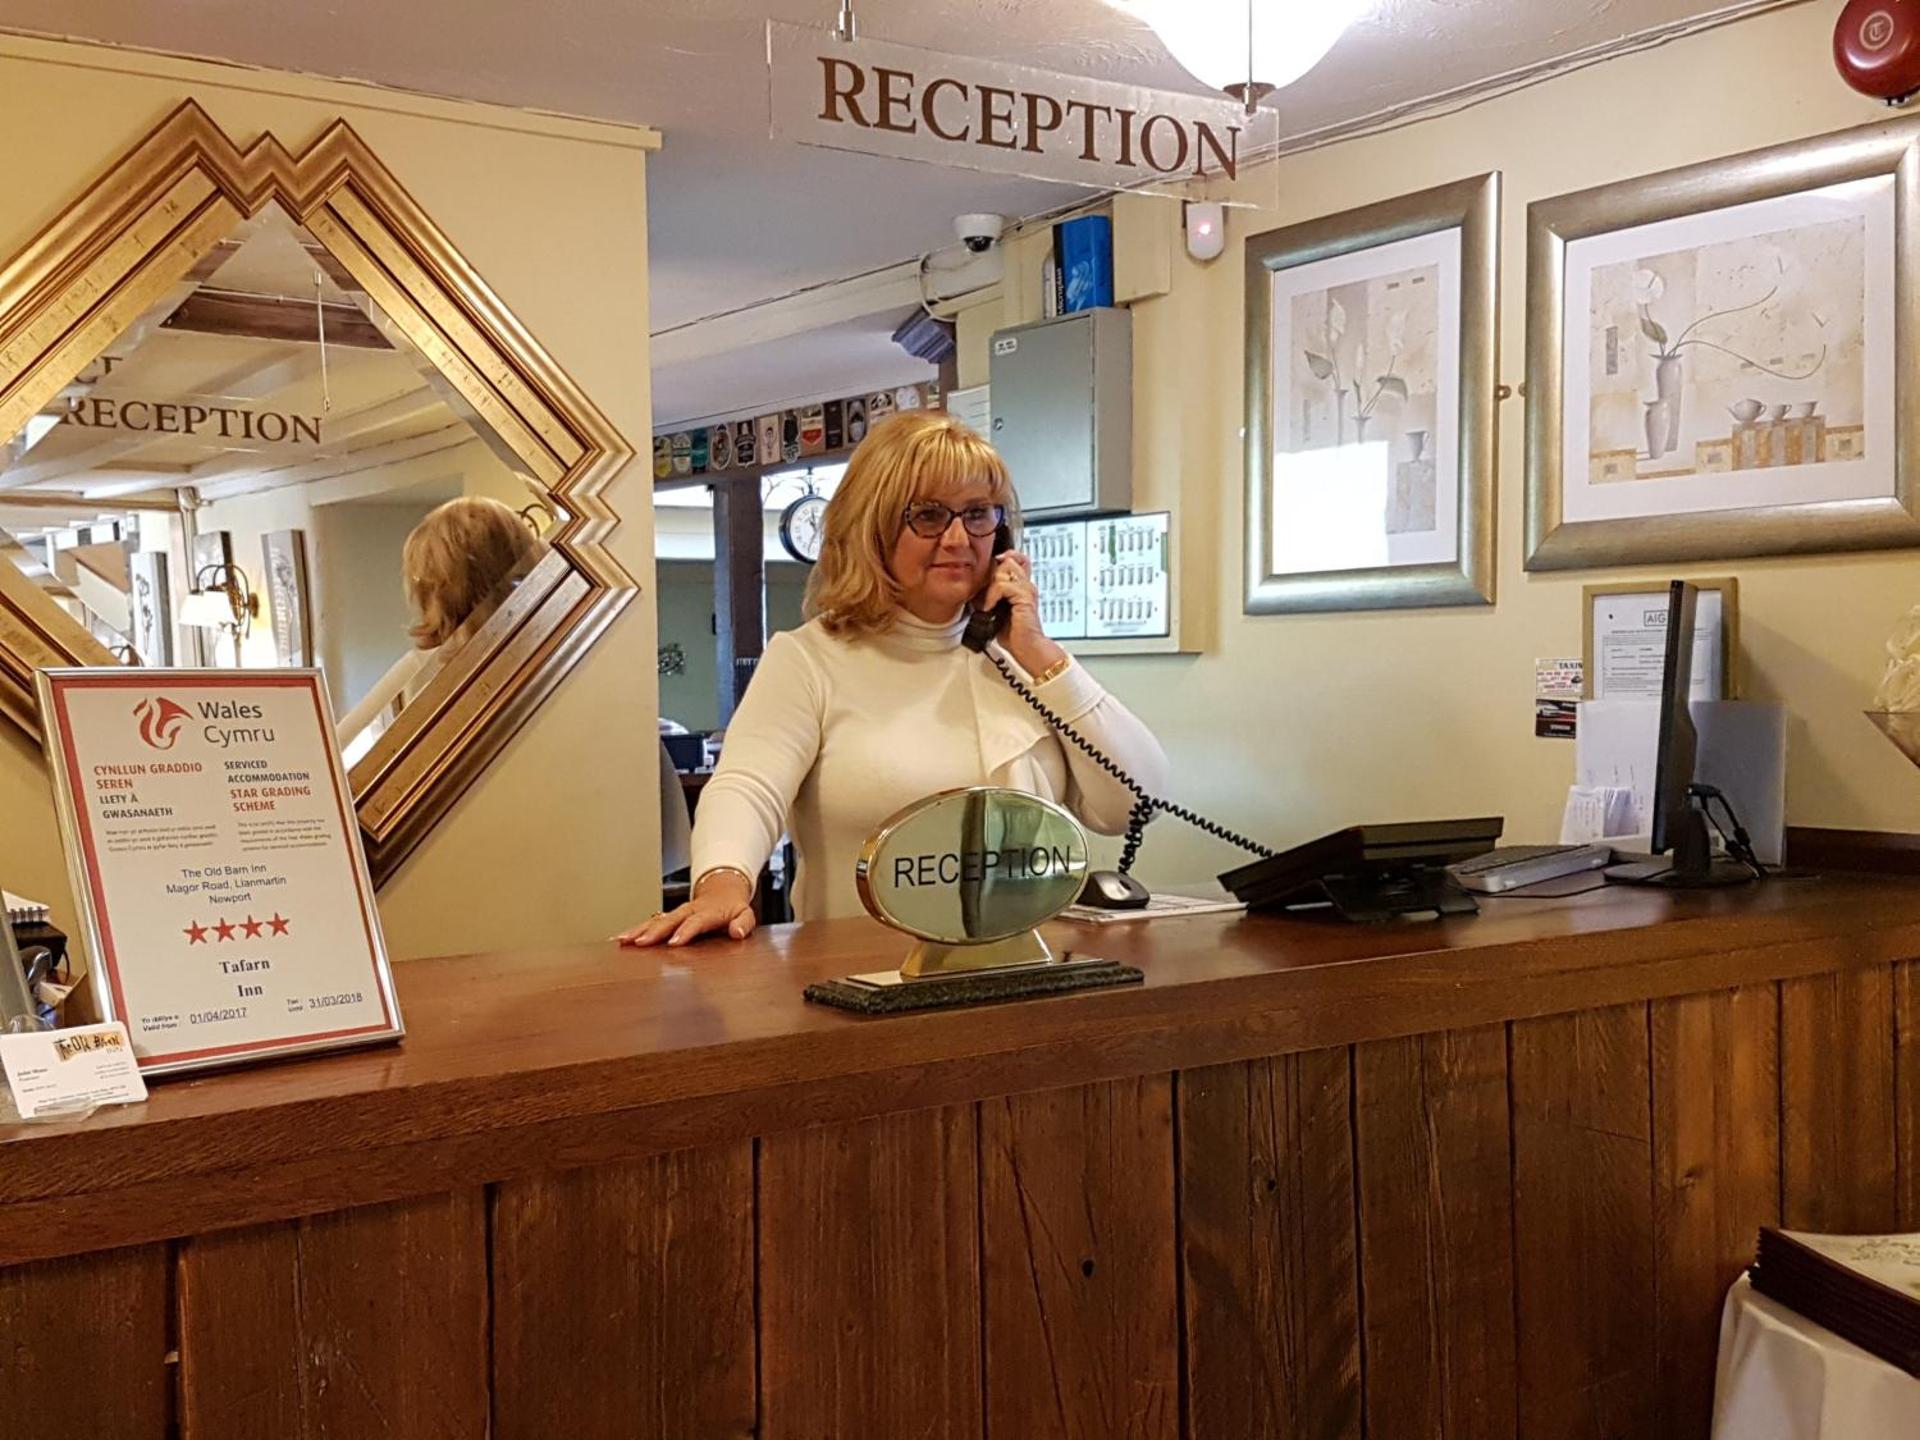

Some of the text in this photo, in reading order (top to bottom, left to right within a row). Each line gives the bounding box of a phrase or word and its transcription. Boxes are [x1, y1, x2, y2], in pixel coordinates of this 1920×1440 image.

[817, 56, 1241, 181] RECEPTION
[60, 397, 322, 445] RECEPTION
[1646, 613, 1667, 624] AIG
[198, 701, 263, 719] Wales
[204, 725, 275, 748] Cymru
[94, 762, 202, 776] CYNLLUN GRADDIO
[224, 760, 267, 770] SERVICED
[96, 779, 133, 790] SEREN
[228, 772, 309, 783] ACCOMMODATION
[99, 795, 126, 804] LLETY
[230, 786, 311, 799] STAR GRADING
[102, 807, 173, 819] GWASANAETH
[233, 801, 275, 812] SCHEME
[181, 868, 201, 878] The
[204, 866, 222, 876] Old
[251, 863, 267, 873] Inn
[894, 845, 1071, 888] RECEPTION
[166, 881, 199, 894] Magor
[209, 892, 252, 905] Newport
[218, 959, 271, 974] Tafarn
[238, 983, 263, 997] Inn
[309, 992, 363, 1009] 31/03/2018
[190, 1007, 248, 1025] 01/04/2017
